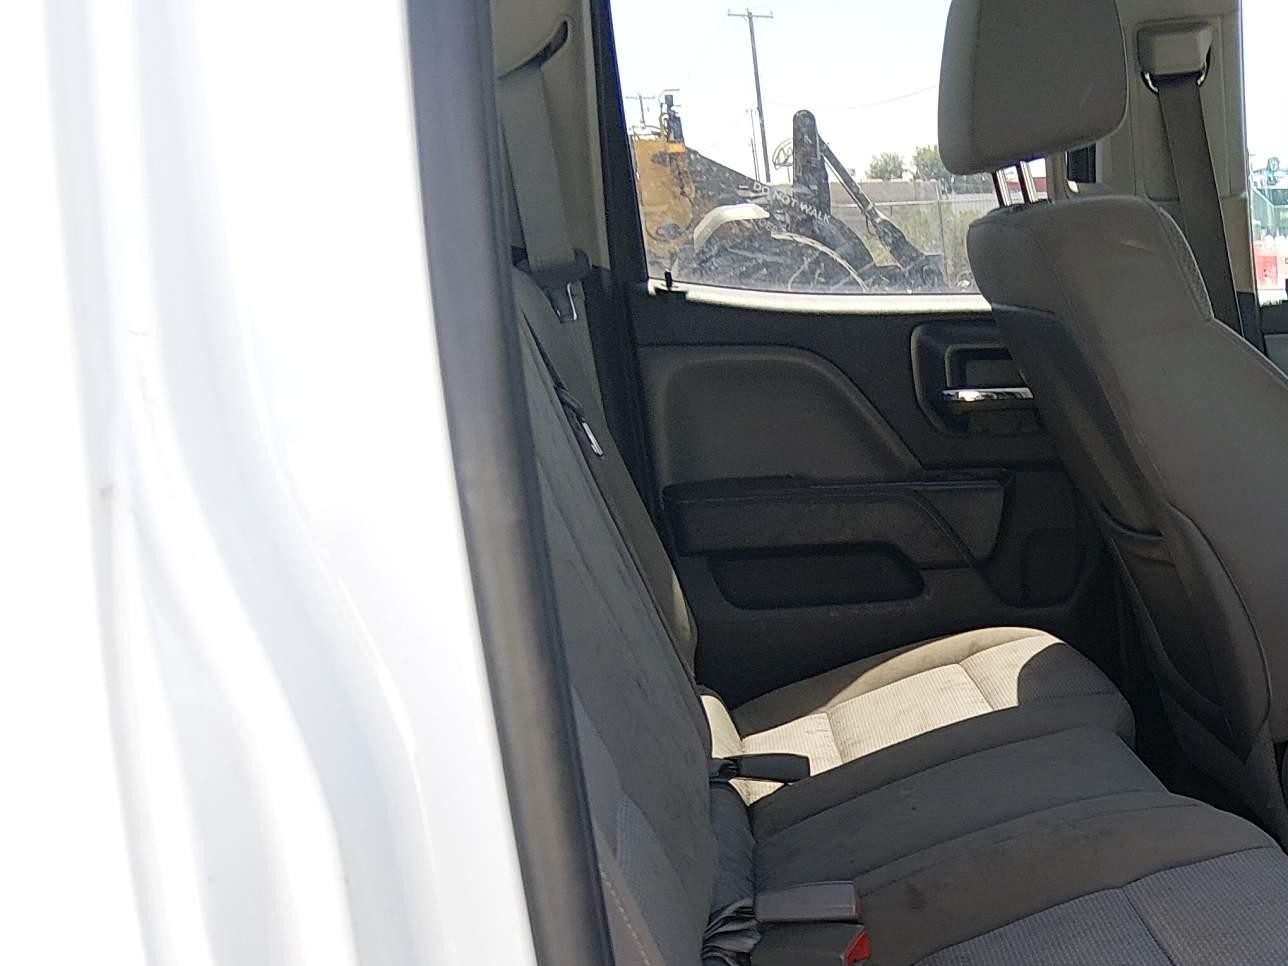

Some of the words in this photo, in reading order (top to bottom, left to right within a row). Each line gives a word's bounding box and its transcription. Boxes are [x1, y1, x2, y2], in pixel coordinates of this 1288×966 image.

[753, 182, 769, 194] DO
[773, 190, 798, 207] NOT
[800, 201, 830, 224] WALK
